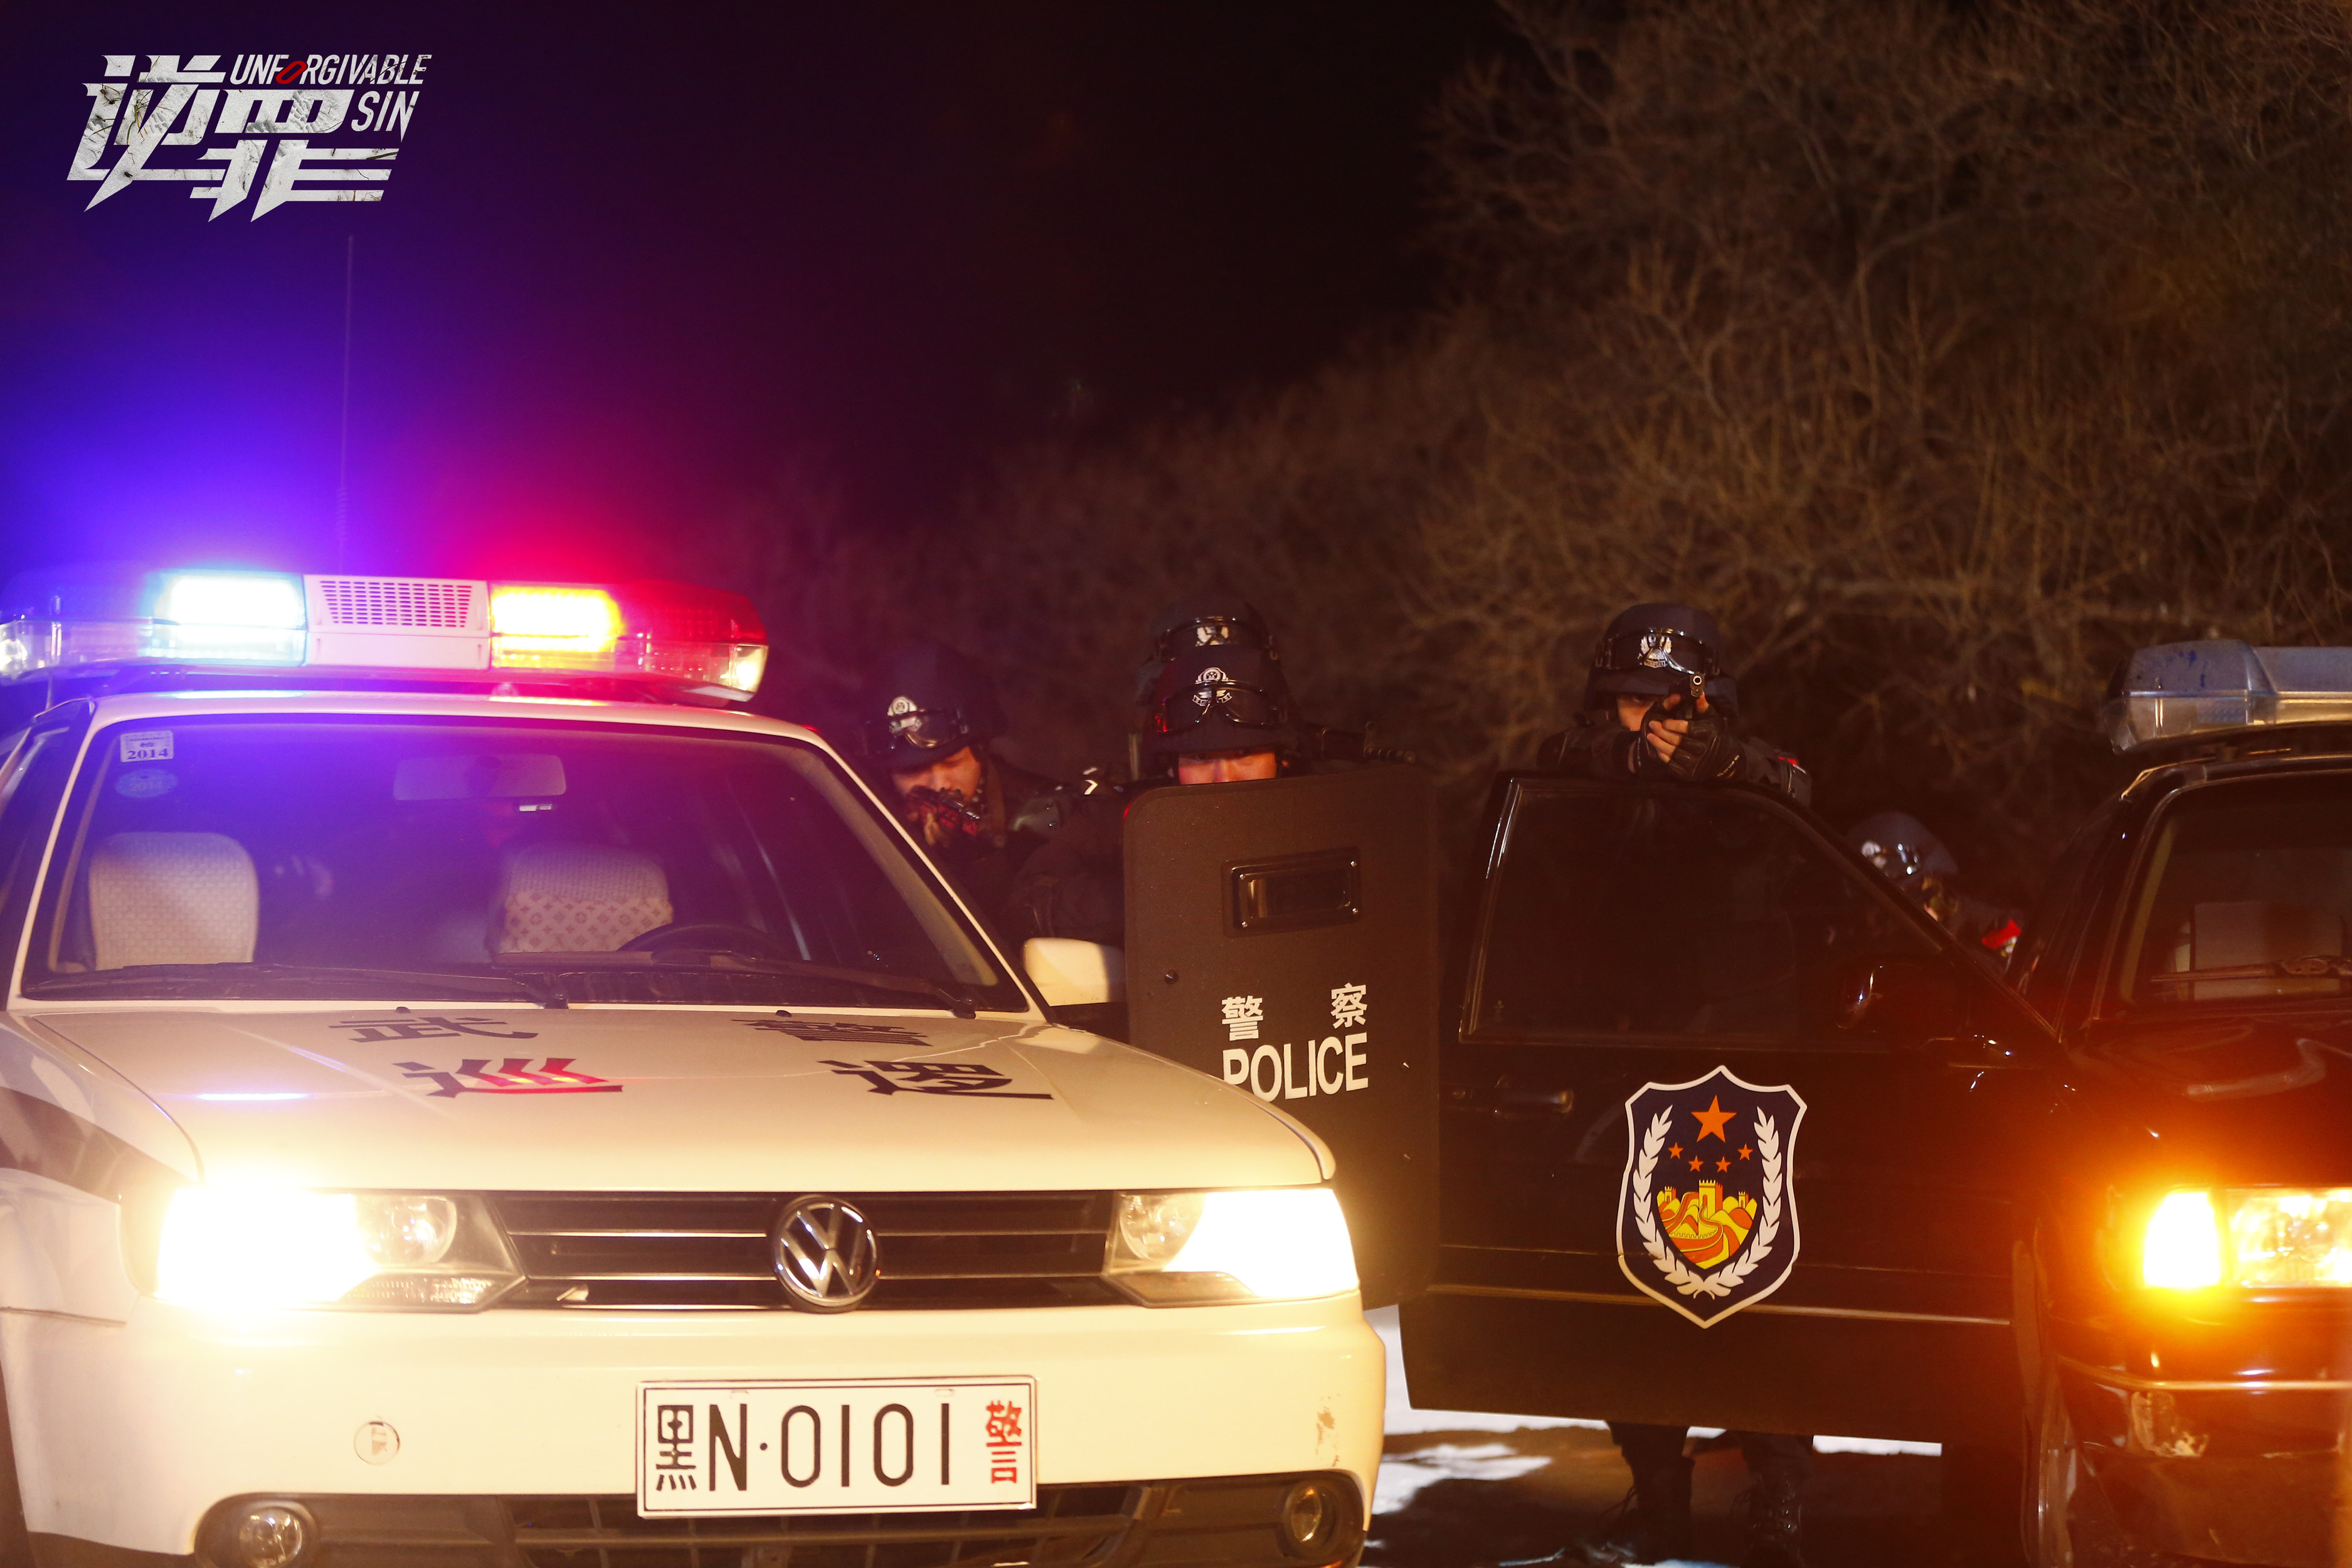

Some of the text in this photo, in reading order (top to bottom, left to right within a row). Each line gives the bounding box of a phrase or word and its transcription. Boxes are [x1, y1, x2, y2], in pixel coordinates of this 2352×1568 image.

[127, 748, 168, 760] 2014
[1222, 982, 1367, 1041] 警 察
[1222, 1032, 1369, 1103] POLICE
